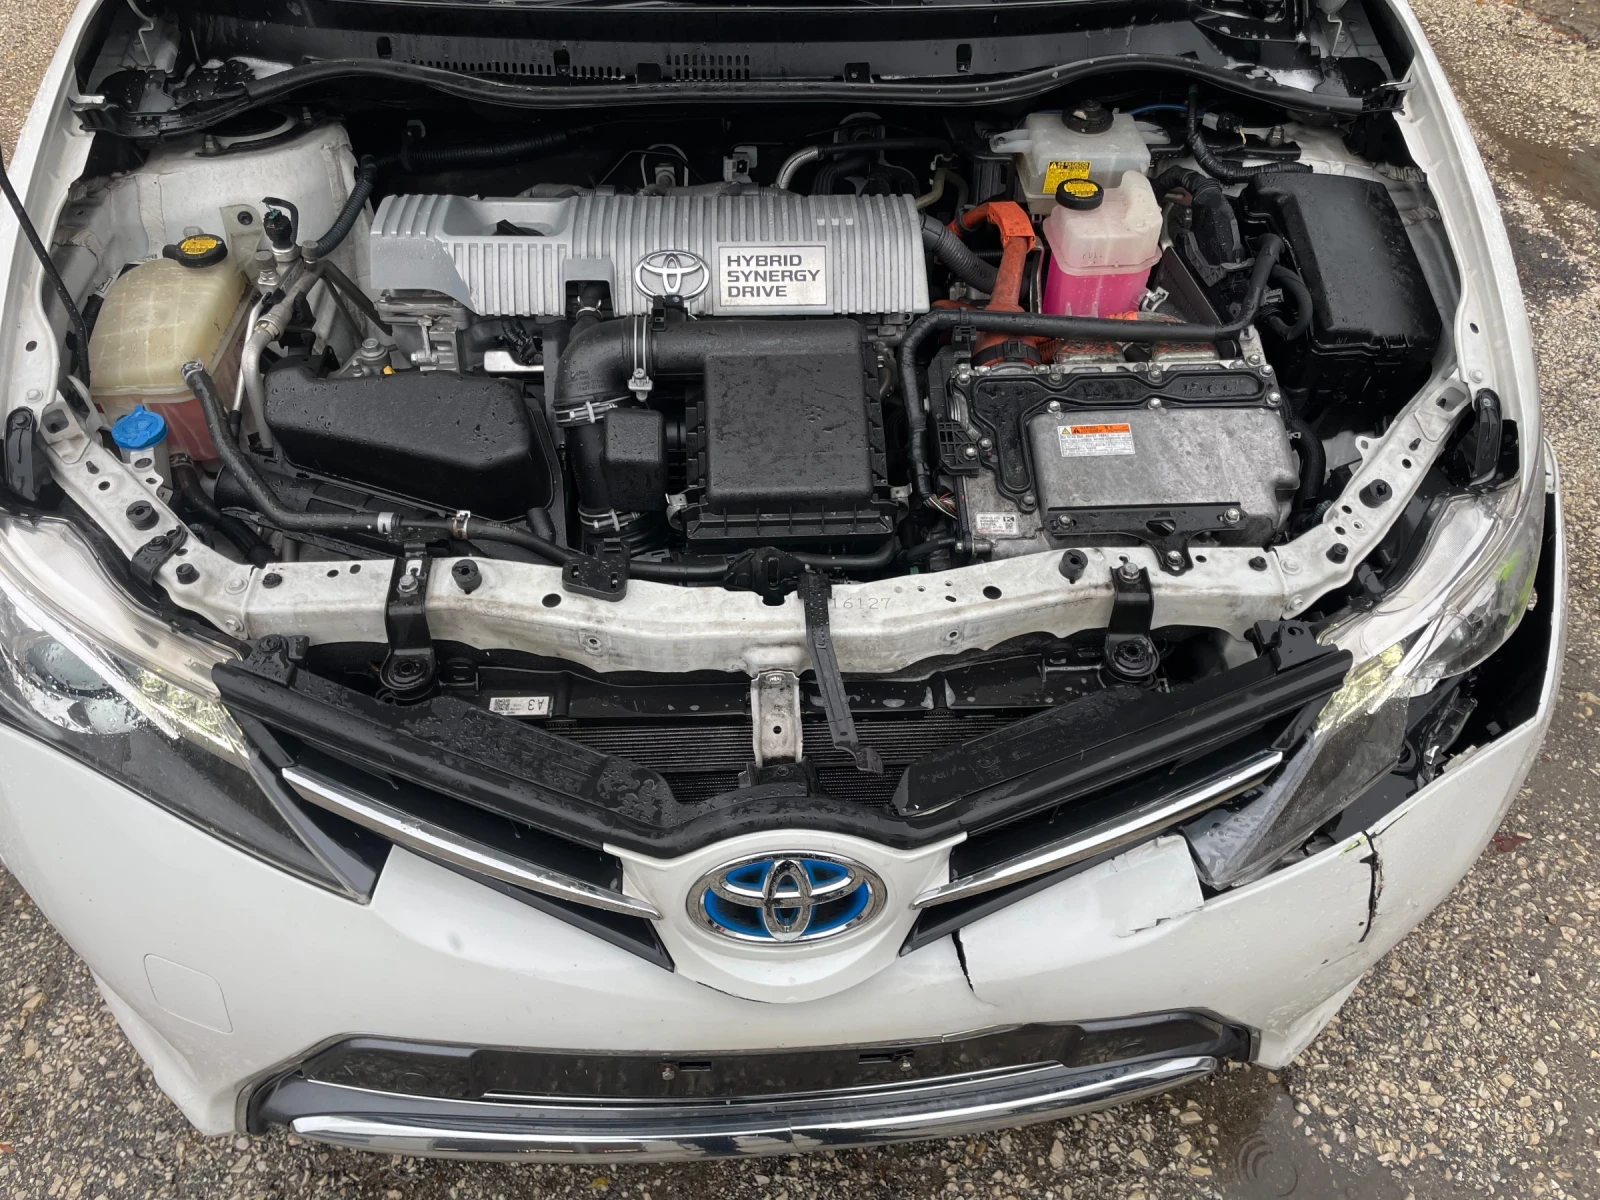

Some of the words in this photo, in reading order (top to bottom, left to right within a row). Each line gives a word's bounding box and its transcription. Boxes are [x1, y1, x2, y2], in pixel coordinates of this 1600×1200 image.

[727, 255, 803, 267] HYBRID
[727, 269, 821, 283] SYNERGY
[727, 285, 788, 298] DRIVE
[832, 597, 891, 610] 16127
[527, 698, 545, 711] A3
